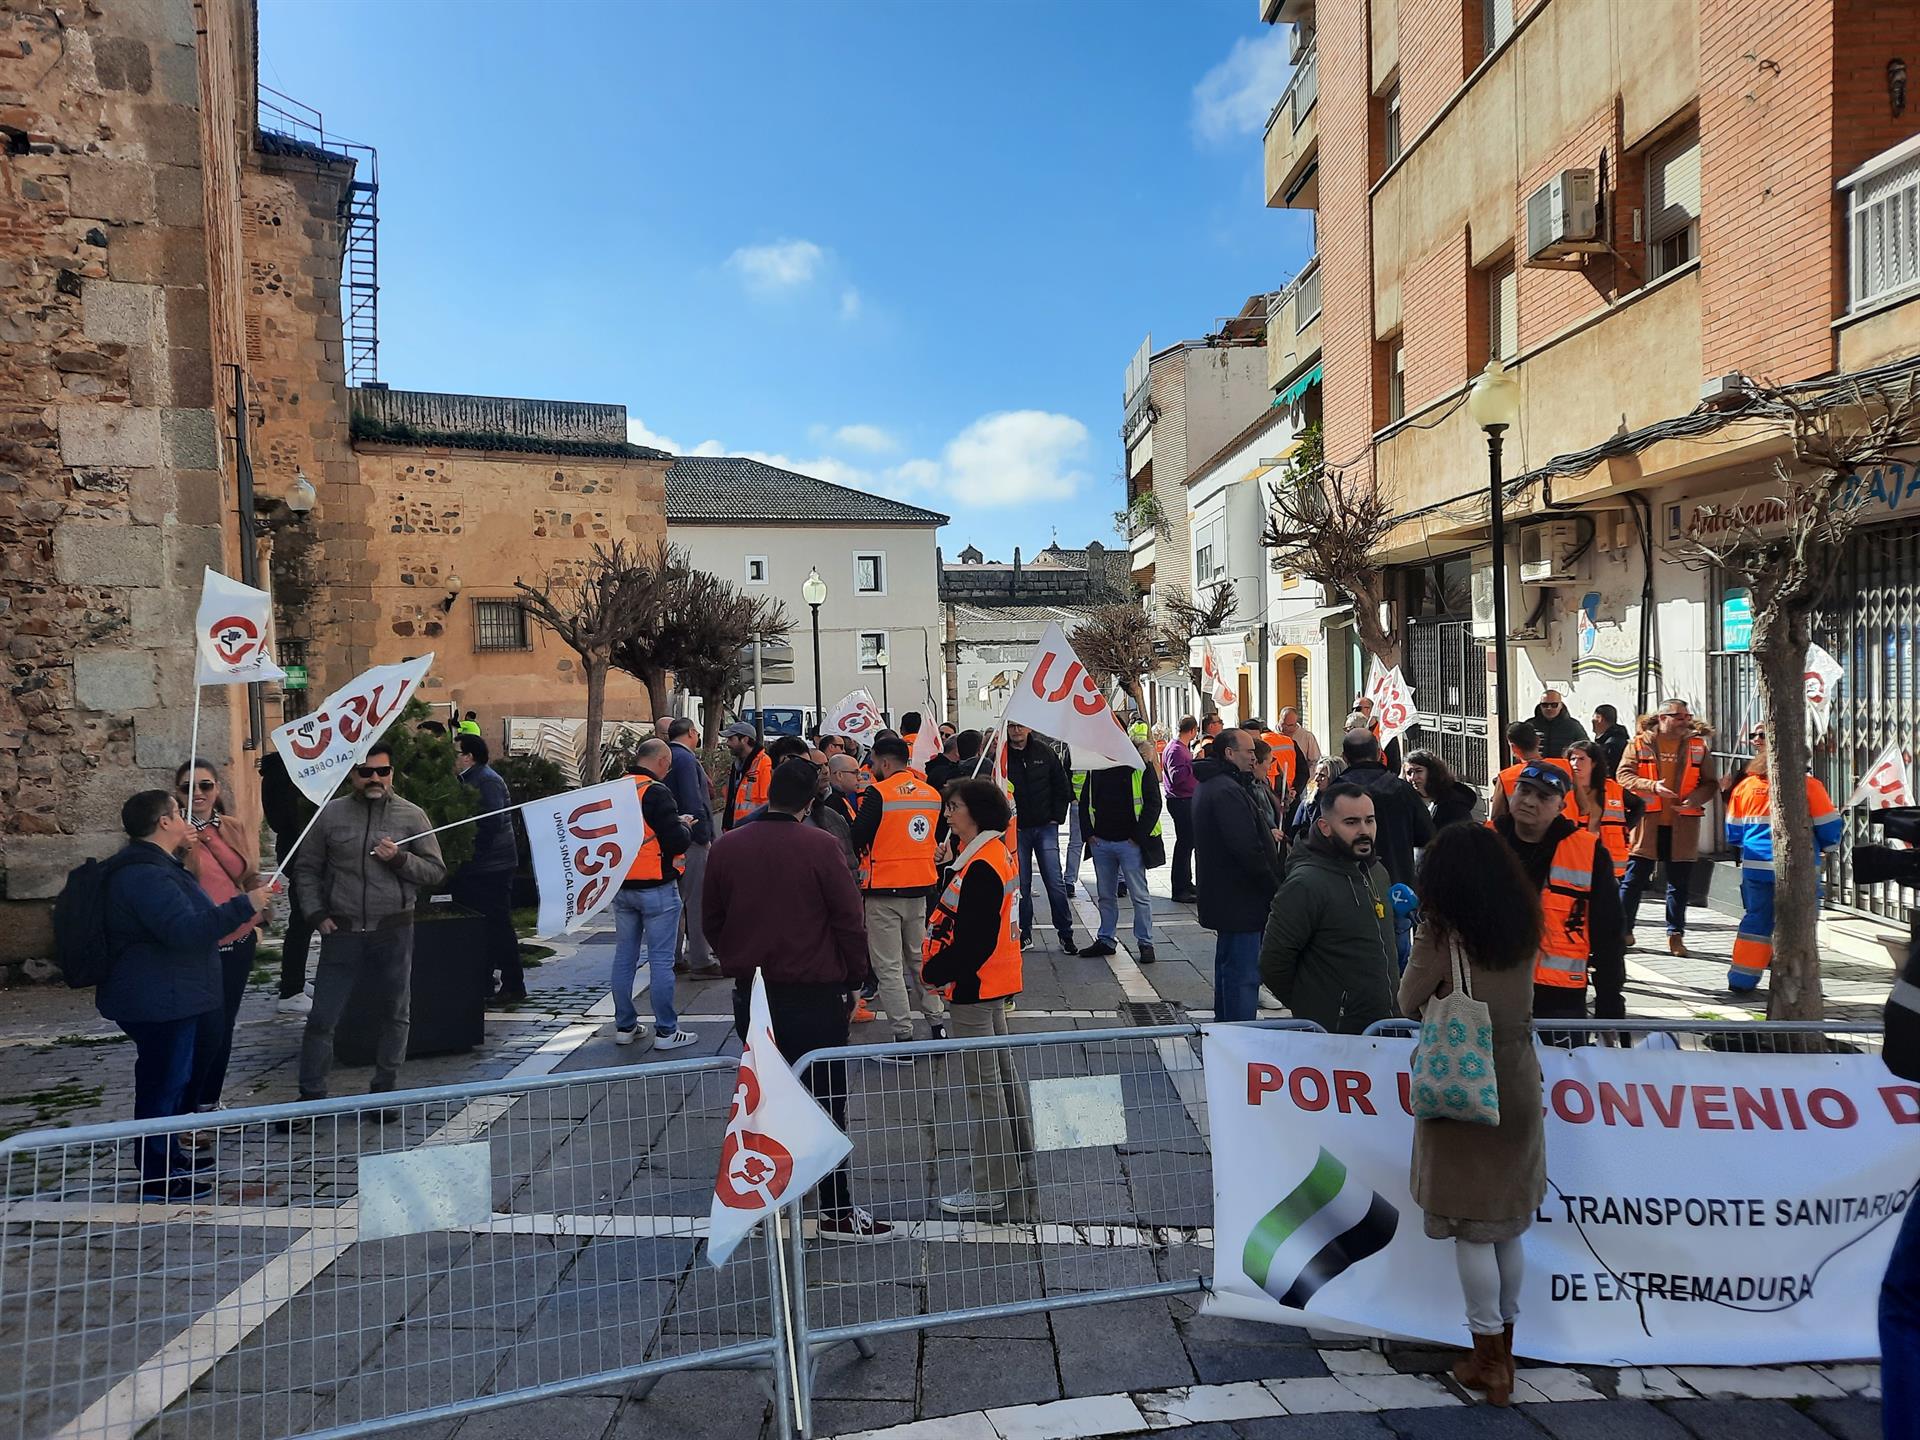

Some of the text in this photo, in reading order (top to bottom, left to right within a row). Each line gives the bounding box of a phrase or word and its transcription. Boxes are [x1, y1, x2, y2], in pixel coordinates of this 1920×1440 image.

[560, 844, 574, 890] SINDICAL
[567, 798, 623, 915] USO
[1247, 1062, 1378, 1116] POR
[1542, 1079, 1859, 1131] ONVENIO
[1559, 1194, 1766, 1228] TRANSPORTE
[1775, 1189, 1907, 1227] SANITARIO
[1551, 1271, 1815, 1304] DE EXTREMADURA
